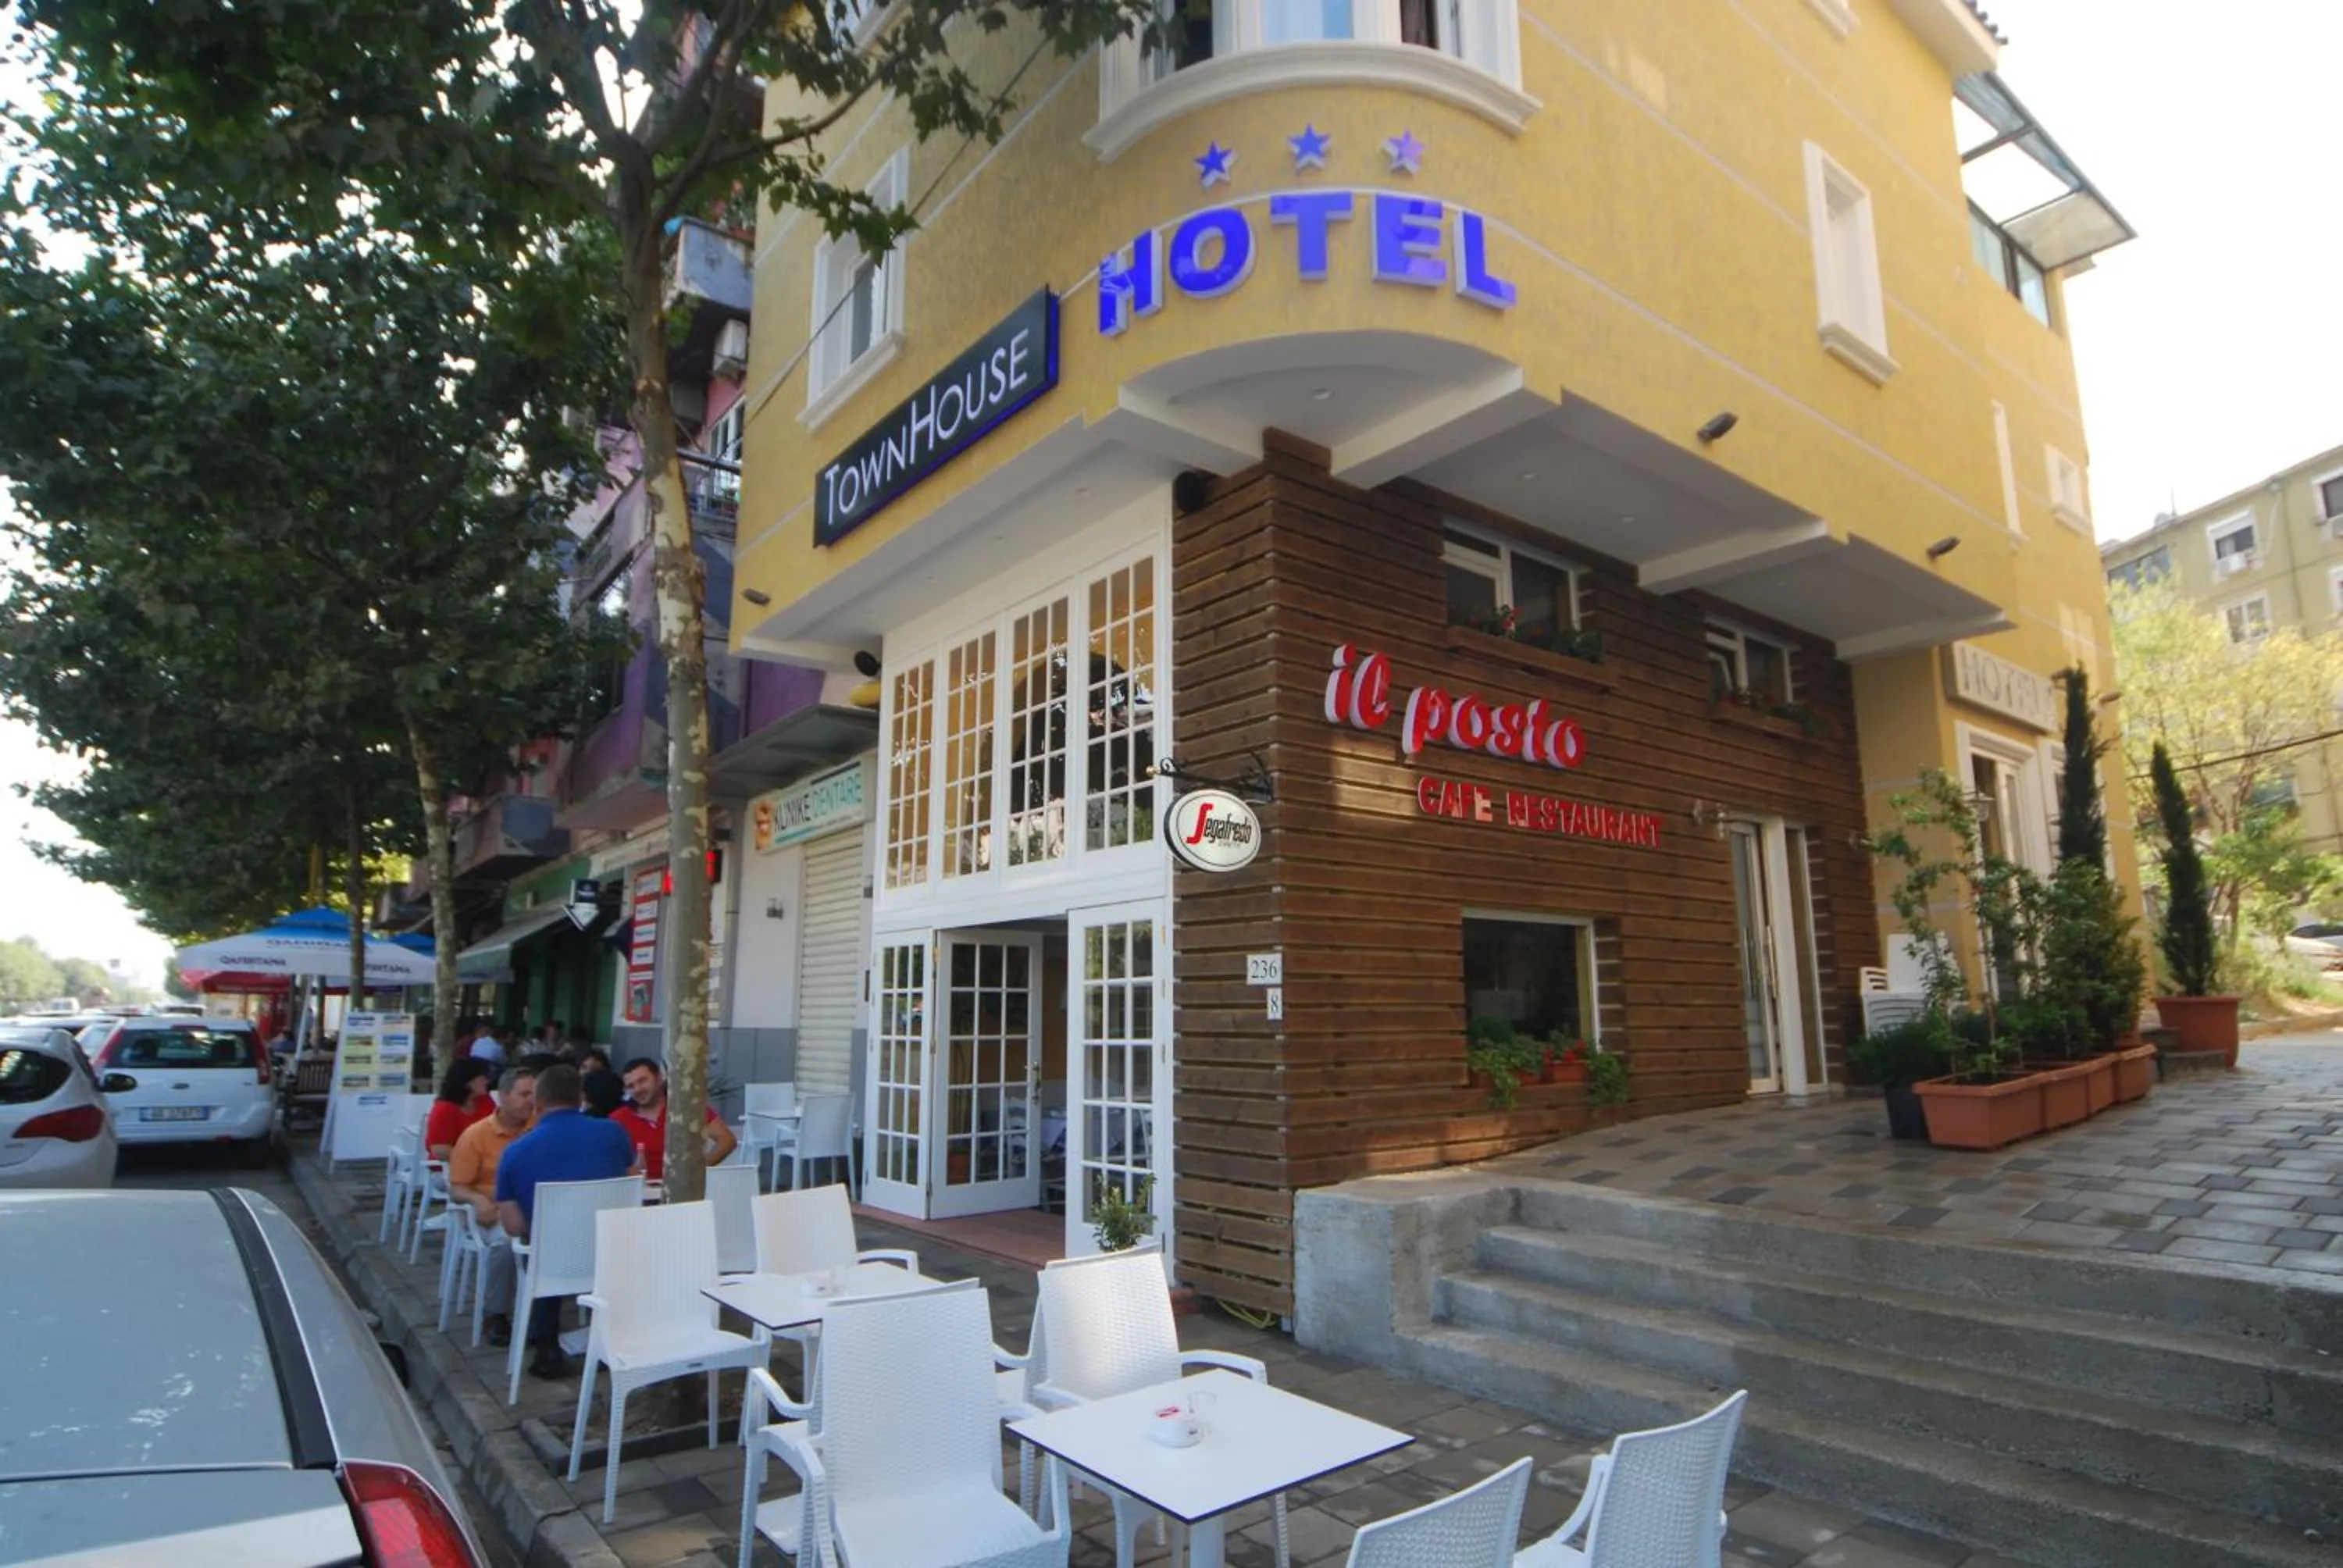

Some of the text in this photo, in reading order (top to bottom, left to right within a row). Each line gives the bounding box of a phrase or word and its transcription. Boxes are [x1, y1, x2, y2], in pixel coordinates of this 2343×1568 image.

[1099, 192, 1517, 337] HOTEL
[1325, 643, 1586, 769] il posto
[811, 773, 862, 818] DENTARE
[1418, 775, 1664, 848] CAFE RESTAURANT
[1186, 803, 1252, 844] Segafredo
[1251, 960, 1277, 978] 236
[1271, 994, 1278, 1014] 8
